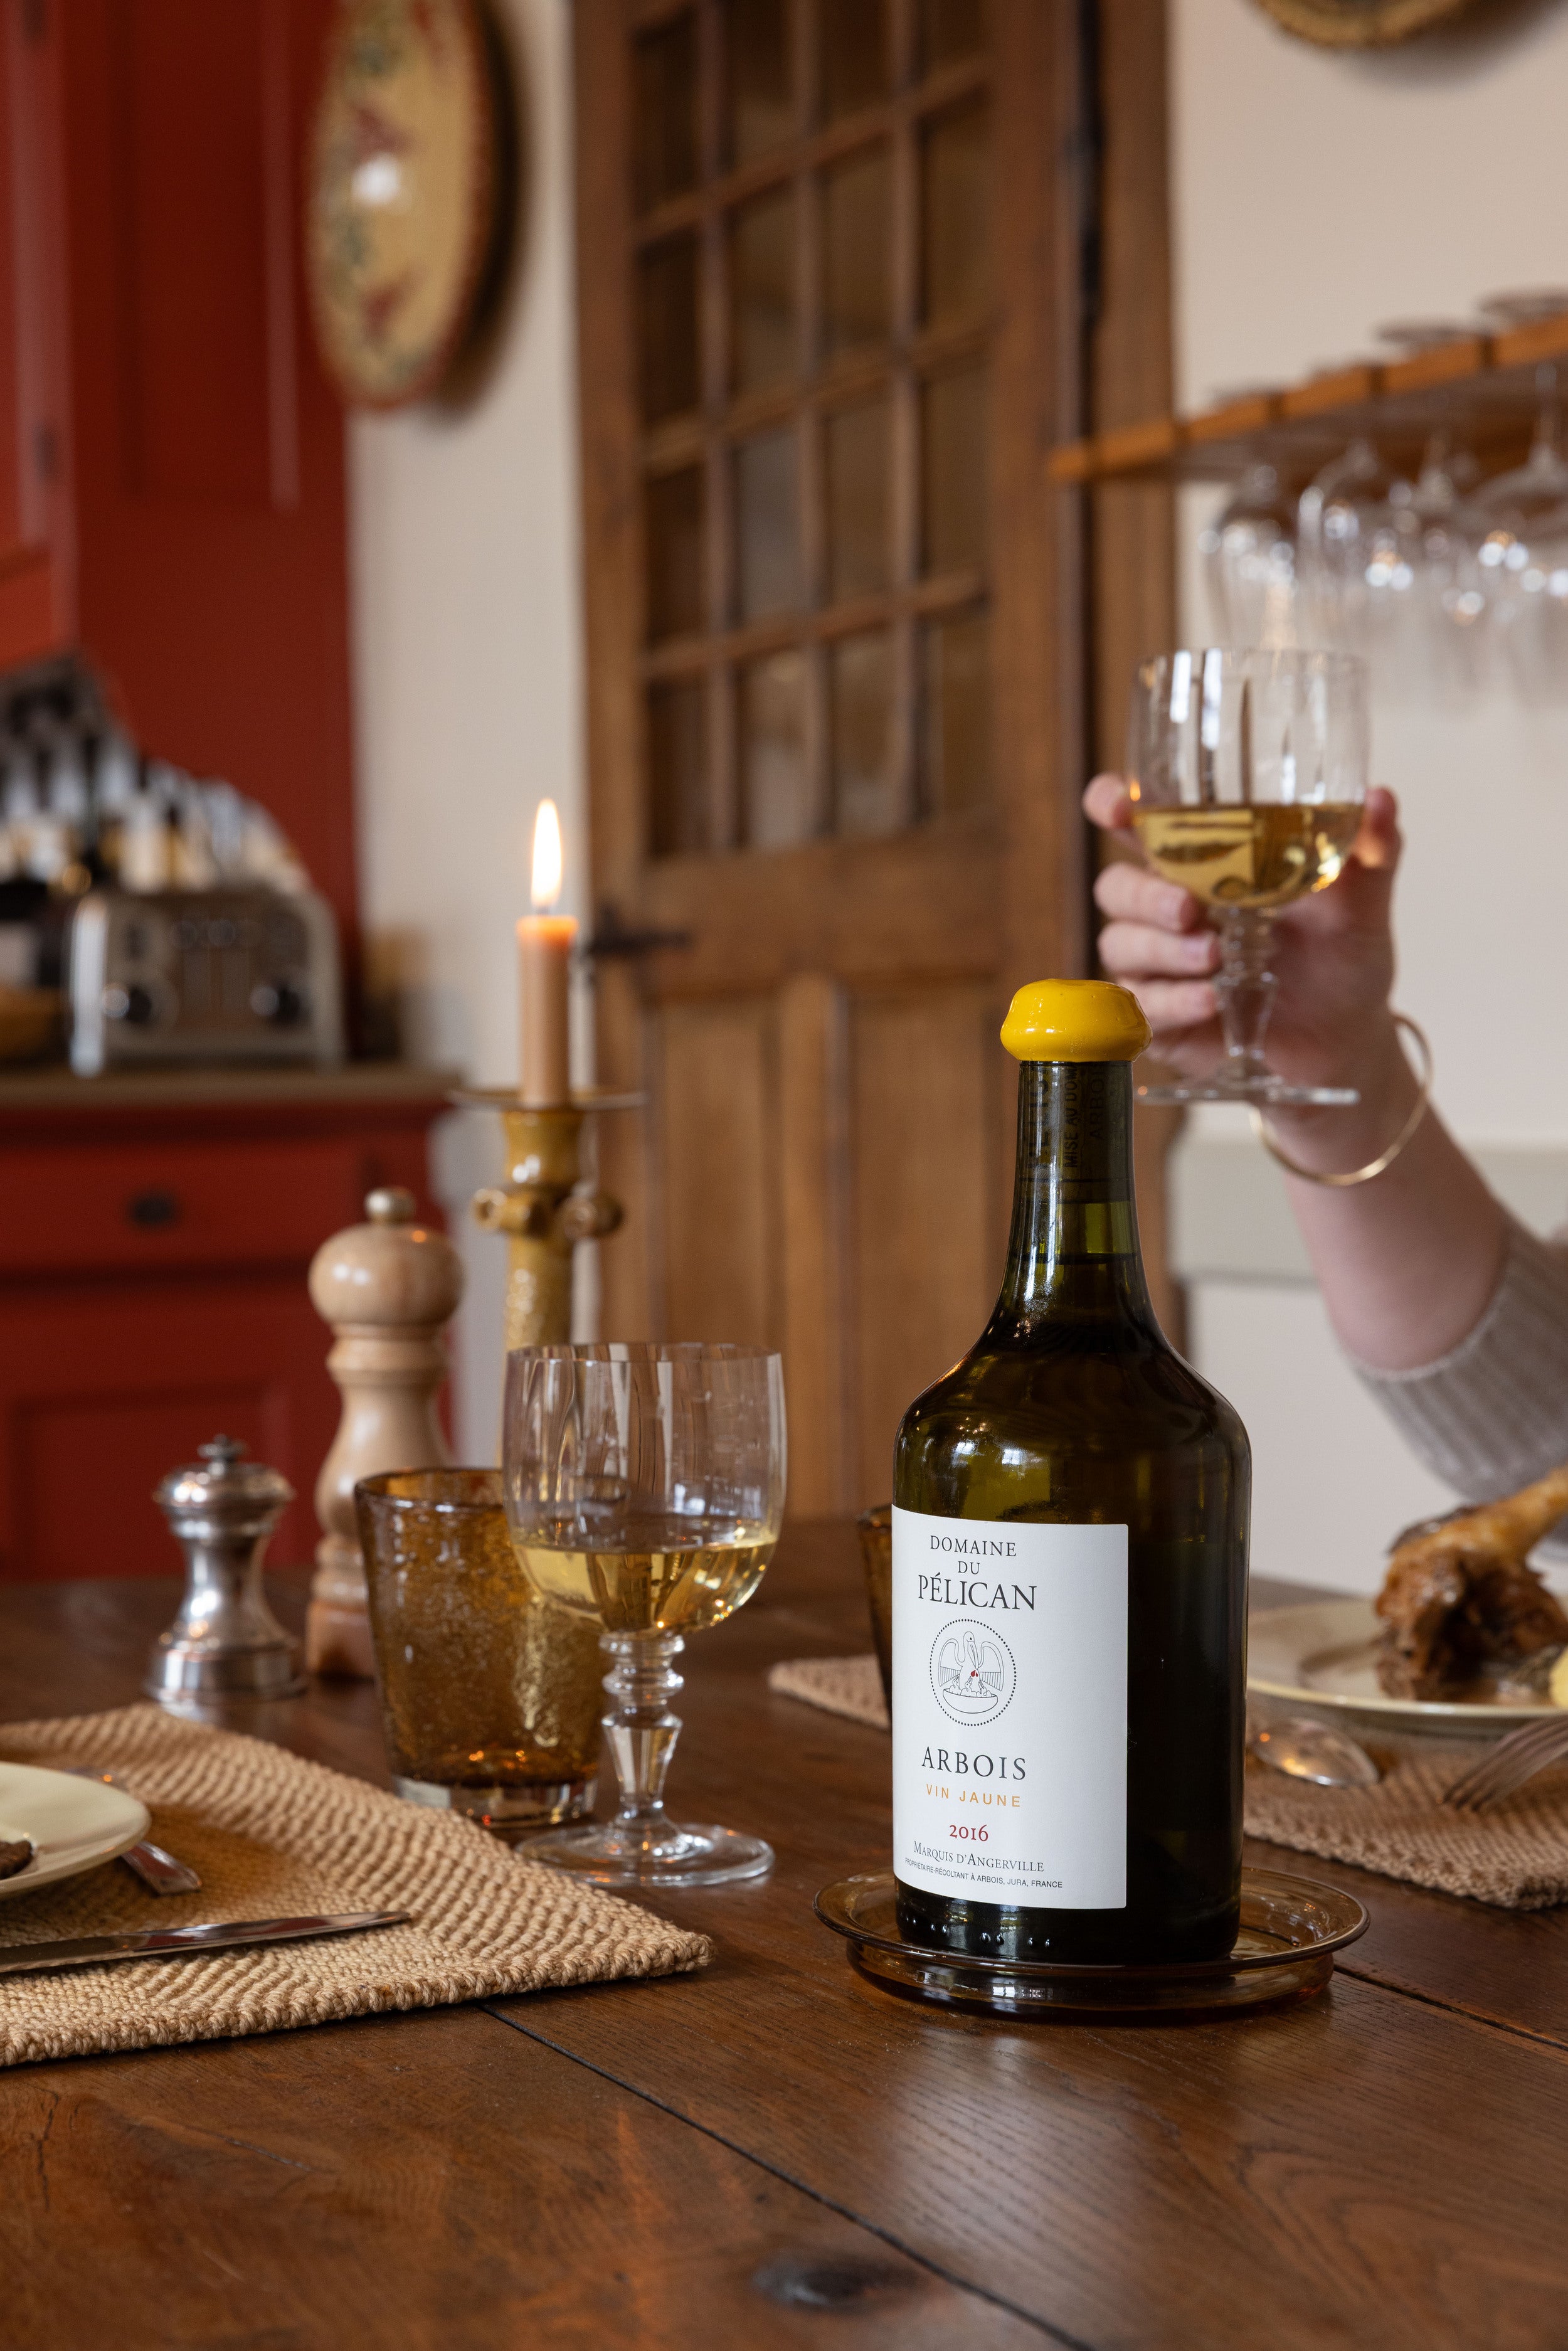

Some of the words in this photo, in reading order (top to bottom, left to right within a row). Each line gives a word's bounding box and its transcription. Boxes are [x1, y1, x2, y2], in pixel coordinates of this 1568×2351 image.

[1089, 1069, 1104, 1140] ARBOI
[1064, 1132, 1078, 1168] MISE
[930, 1535, 1017, 1557] DOMAINE
[957, 1560, 981, 1574] DU
[918, 1571, 1037, 1611] PÉLICAN
[921, 1746, 1026, 1780] ARBOIS
[926, 1783, 949, 1799] VIN
[959, 1790, 1020, 1807] JAUNE
[949, 1824, 989, 1842] 2016
[905, 1857, 969, 1880] PROPRIÉTAIRE-RÉCOLTANT
[970, 1872, 976, 1881] À
[977, 1875, 1005, 1886] ARBOIS,
[1007, 1878, 1029, 1887] JURA,
[1031, 1879, 1063, 1888] FRANCE
